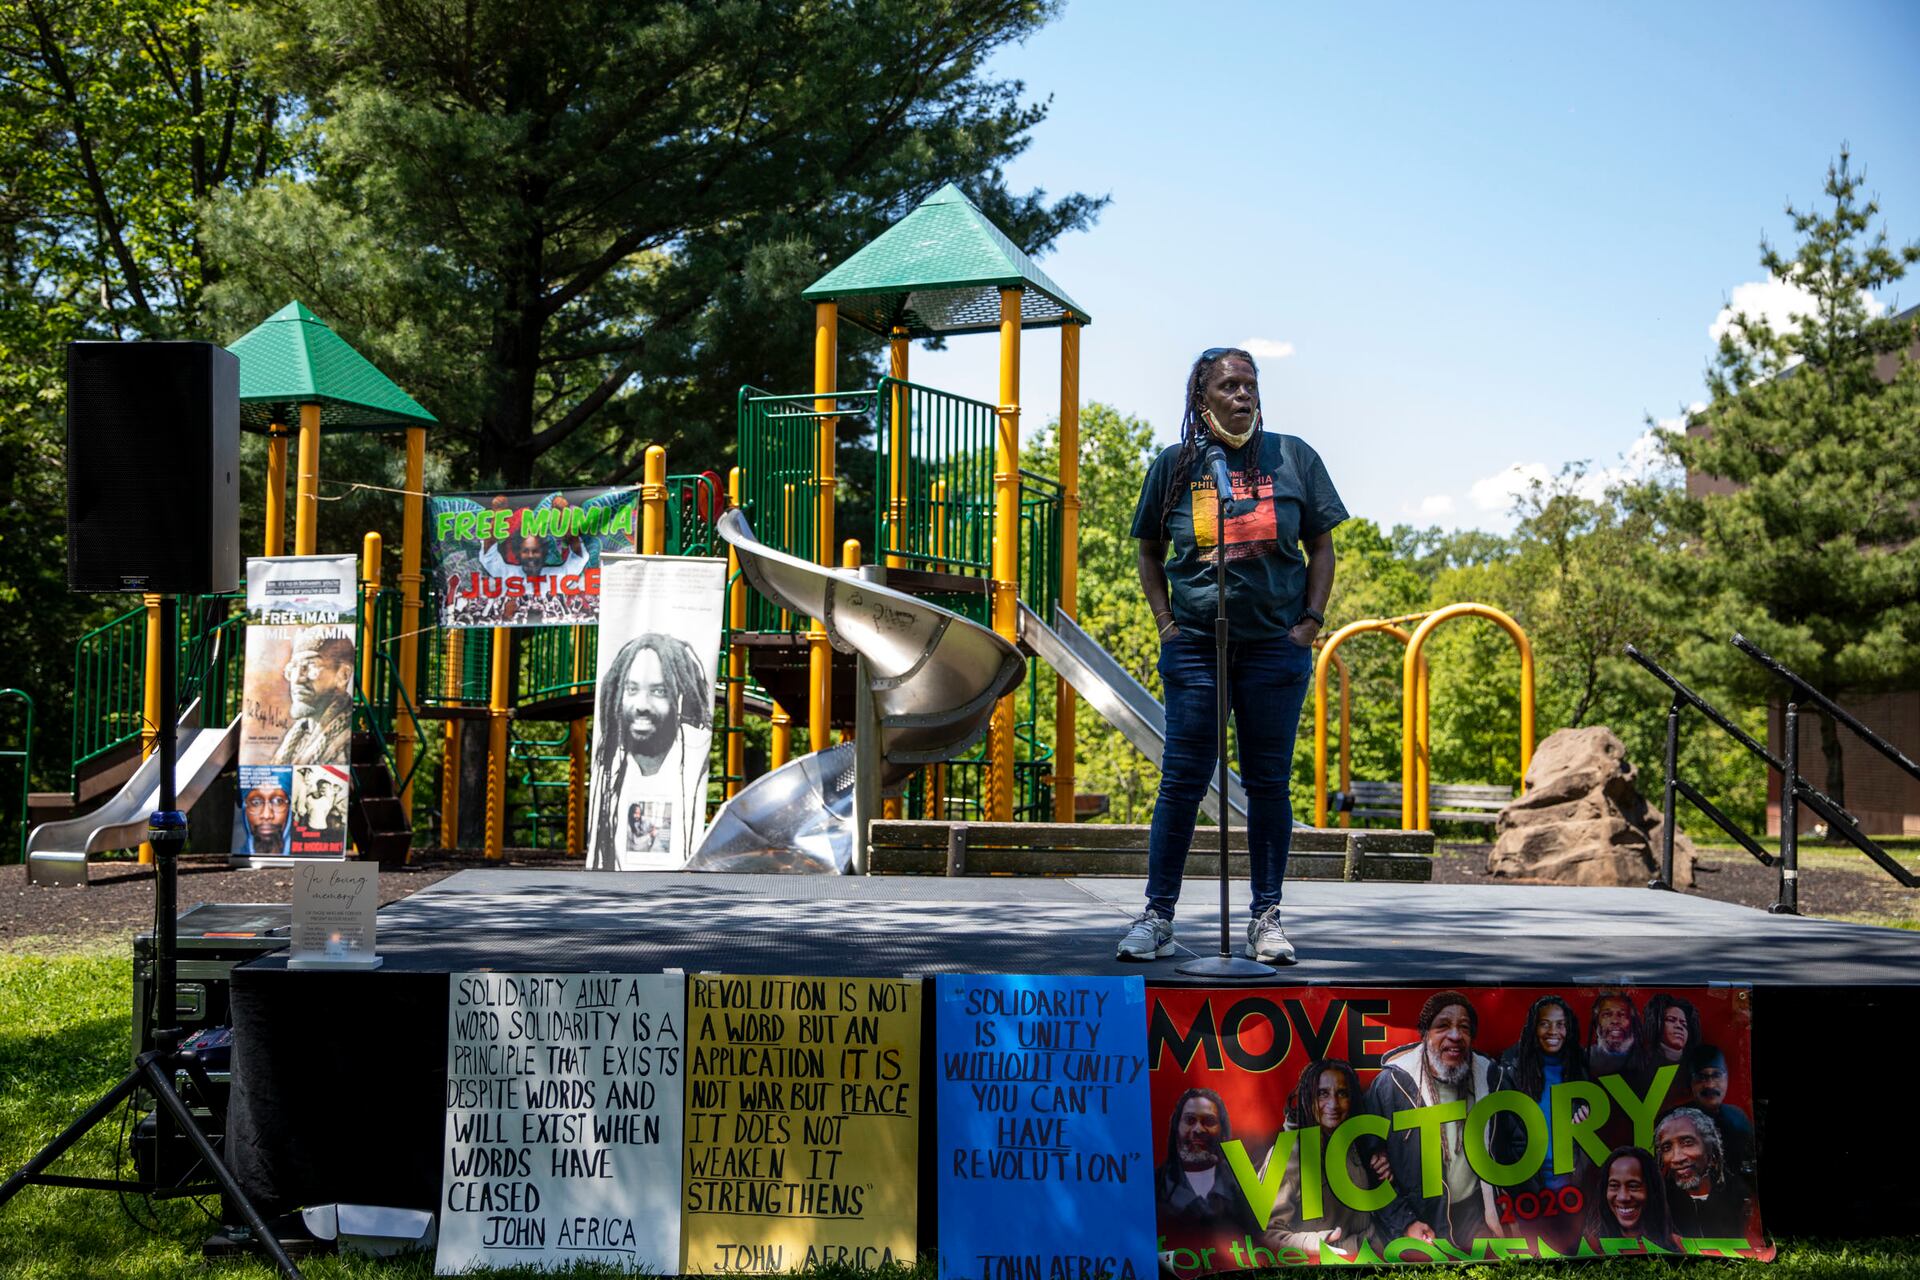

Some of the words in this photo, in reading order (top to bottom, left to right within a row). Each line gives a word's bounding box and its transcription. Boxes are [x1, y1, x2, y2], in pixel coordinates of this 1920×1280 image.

[1190, 475, 1272, 490] PHILELHIA
[438, 508, 513, 541] FREE
[520, 504, 633, 539] MUMIA
[462, 568, 600, 599] JUSTICE
[261, 611, 298, 625] FREE
[301, 610, 340, 624] IMAM
[303, 865, 320, 892] In
[330, 869, 368, 894] loving
[312, 893, 355, 909] memory
[458, 977, 569, 1007] SOLIDARITY
[576, 978, 622, 1007] AINT
[626, 978, 640, 1007] A
[839, 982, 856, 1012] IS
[869, 983, 911, 1013] NOT
[455, 1011, 500, 1041] WORD
[508, 1011, 621, 1041] SOLIDARITY
[633, 1012, 650, 1041] IS
[657, 1012, 678, 1042] A
[700, 1013, 716, 1041] A
[725, 1013, 785, 1041] WORD
[799, 1015, 838, 1044] BUT
[844, 1016, 879, 1044] AN
[975, 1020, 996, 1047] IS
[1018, 1021, 1100, 1048] UNITY
[1149, 997, 1390, 1073] MOVE
[454, 1045, 536, 1075] PRINCIPLE
[546, 1046, 591, 1075] THAT
[603, 1046, 680, 1076] EXISTS
[692, 1047, 825, 1078] APPLICATION
[840, 1049, 868, 1079] IT
[876, 1049, 901, 1080] IS
[944, 1052, 1055, 1080] WITHOUT
[1063, 1054, 1145, 1084] UNITY
[447, 1078, 519, 1109] DESPITE
[525, 1080, 596, 1109] WORDS
[605, 1080, 655, 1110] AND
[691, 1080, 731, 1109] NOT
[739, 1081, 784, 1110] WAR
[790, 1083, 834, 1111] BUT
[841, 1083, 909, 1113] PEACE
[971, 1084, 1018, 1112] YOU
[1031, 1084, 1114, 1114] CAN'T
[453, 1113, 508, 1143] WILL
[523, 1113, 586, 1144] EXIST
[593, 1114, 660, 1144] WHEN
[689, 1113, 727, 1143] IT
[734, 1114, 791, 1144] DOES
[803, 1115, 849, 1145] NOT
[998, 1117, 1072, 1148] HAVE
[451, 1147, 531, 1177] WORDS
[551, 1148, 614, 1178] HAVE
[1221, 1064, 1679, 1231] VICTORY
[689, 1147, 785, 1178] WEAKEN
[806, 1150, 842, 1180] IT
[448, 1182, 540, 1212] CEASED
[1497, 1186, 1583, 1224] 2020
[483, 1216, 545, 1246] JOHN
[558, 1217, 636, 1247] AFRICA
[713, 1244, 783, 1272] JOHN
[802, 1244, 895, 1271] AFRICA
[976, 1254, 1041, 1280] JOHN
[1050, 1254, 1137, 1280] AFRICA
[1229, 1235, 1311, 1269] the
